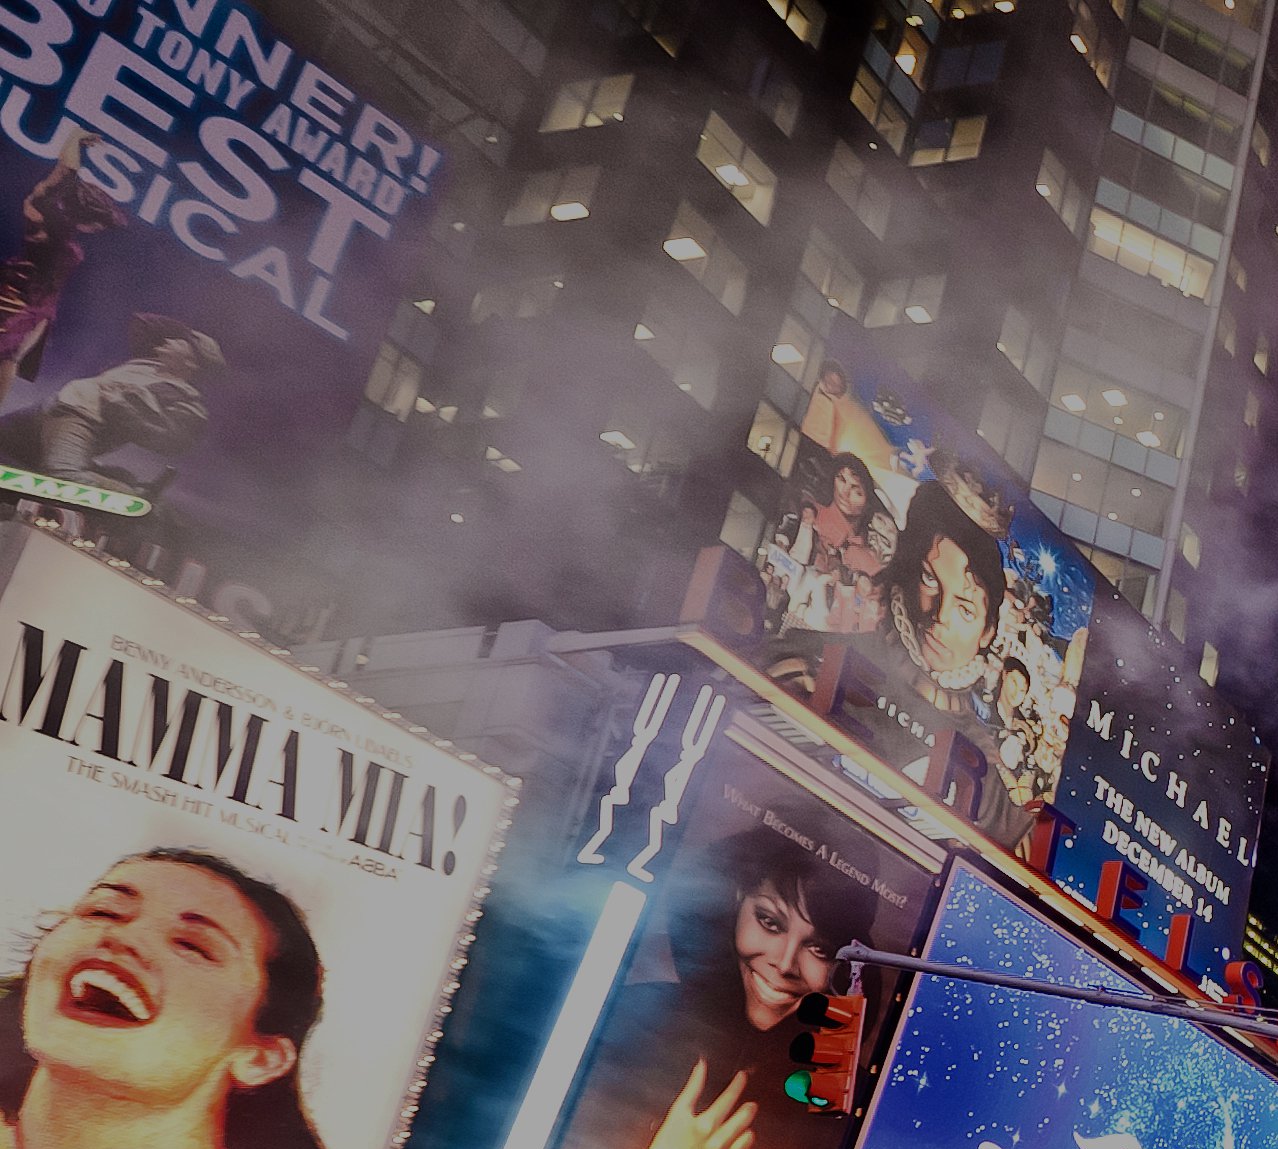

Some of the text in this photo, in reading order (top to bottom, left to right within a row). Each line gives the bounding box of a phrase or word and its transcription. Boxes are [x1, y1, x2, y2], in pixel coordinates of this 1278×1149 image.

[0, 0, 393, 275] BEST
[133, 10, 408, 215] TONY AWARD
[0, 85, 349, 341] USICAL
[0, 620, 468, 878] MAMMA MIA!
[66, 757, 102, 784] THE
[110, 771, 176, 807] SMASH
[1086, 700, 1250, 867] MICHAEL
[816, 844, 829, 860] A
[1093, 775, 1231, 906] THE NEW ALBUM
[1101, 819, 1214, 923] DECEMBER 14
